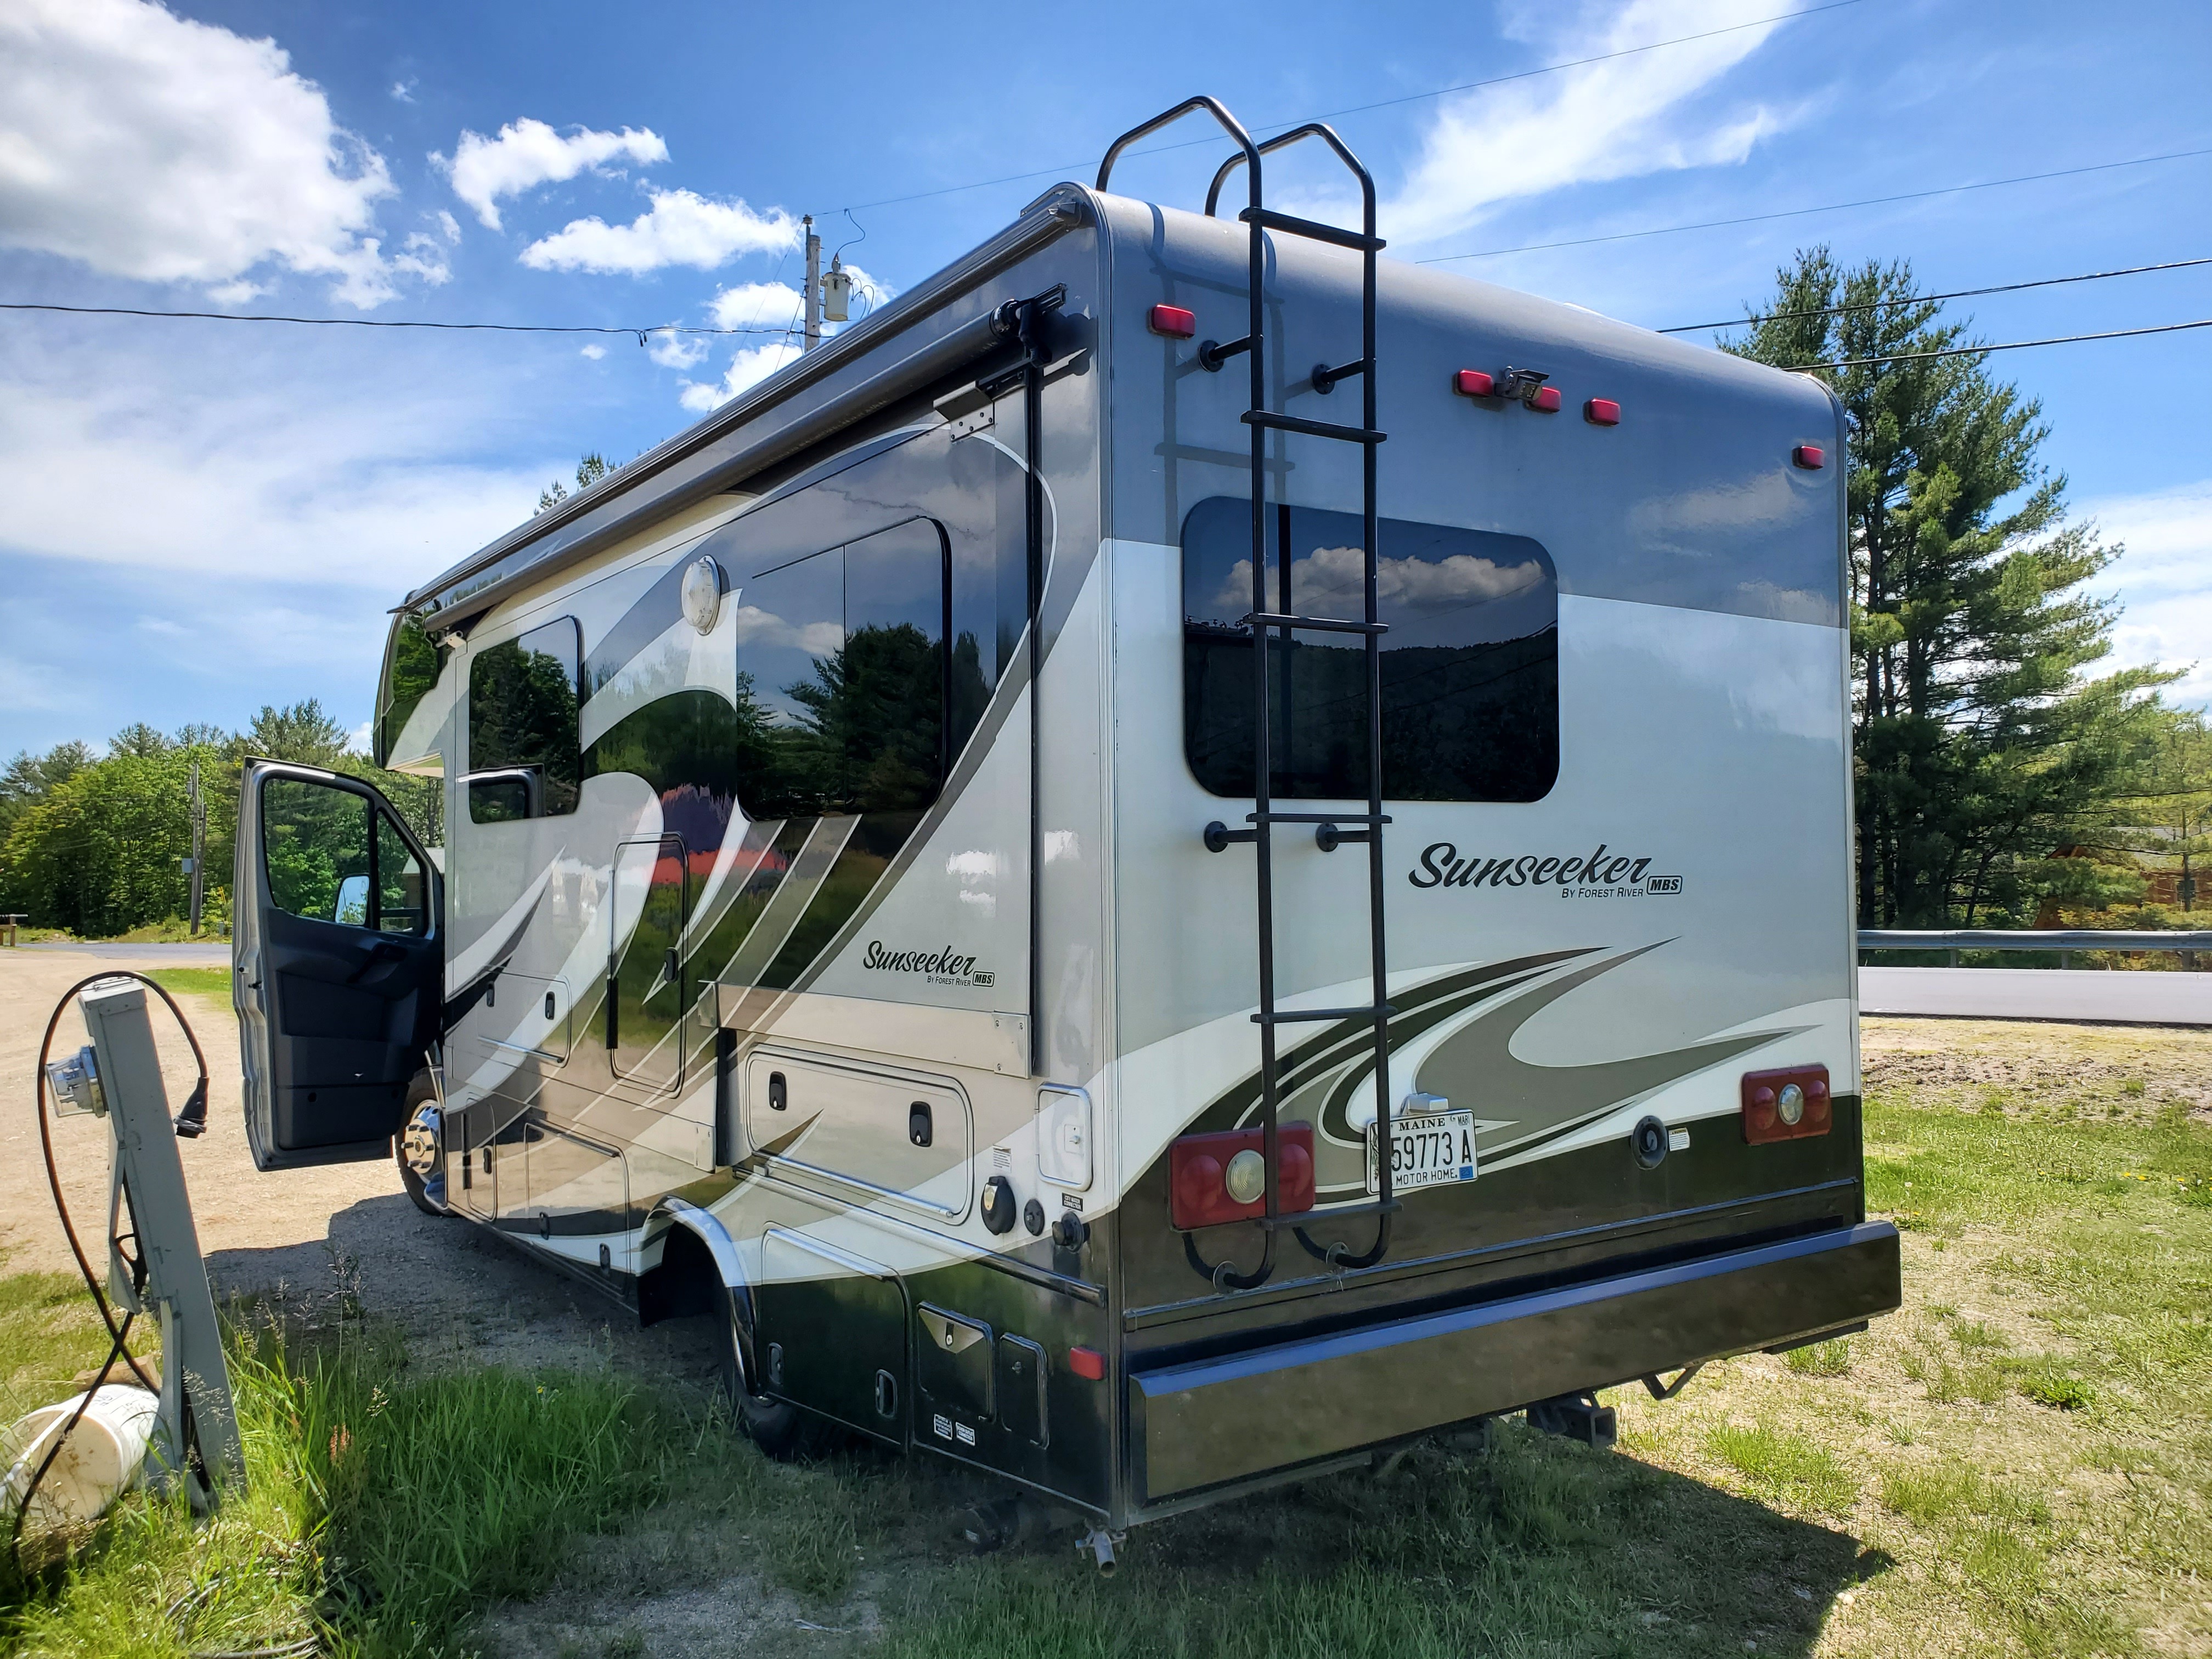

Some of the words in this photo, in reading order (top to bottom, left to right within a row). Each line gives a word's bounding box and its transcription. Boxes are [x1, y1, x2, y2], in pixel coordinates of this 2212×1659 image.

[1408, 842, 1652, 889] Sunseeker
[1650, 878, 1679, 892] MBS
[1562, 888, 1576, 898] BY
[1578, 888, 1615, 898] FOREST
[1617, 887, 1644, 898] RIVER
[863, 940, 977, 977] Sunseeker
[935, 976, 955, 985] FOREST
[956, 978, 971, 986] RIVER
[974, 974, 992, 984] MBS
[1399, 1118, 1446, 1131] MAINE
[1458, 1115, 1468, 1125] MAR
[1391, 1131, 1453, 1172] 59773
[1462, 1129, 1472, 1164] A
[1396, 1172, 1428, 1186] MOTOR
[1431, 1168, 1455, 1181] HOME
